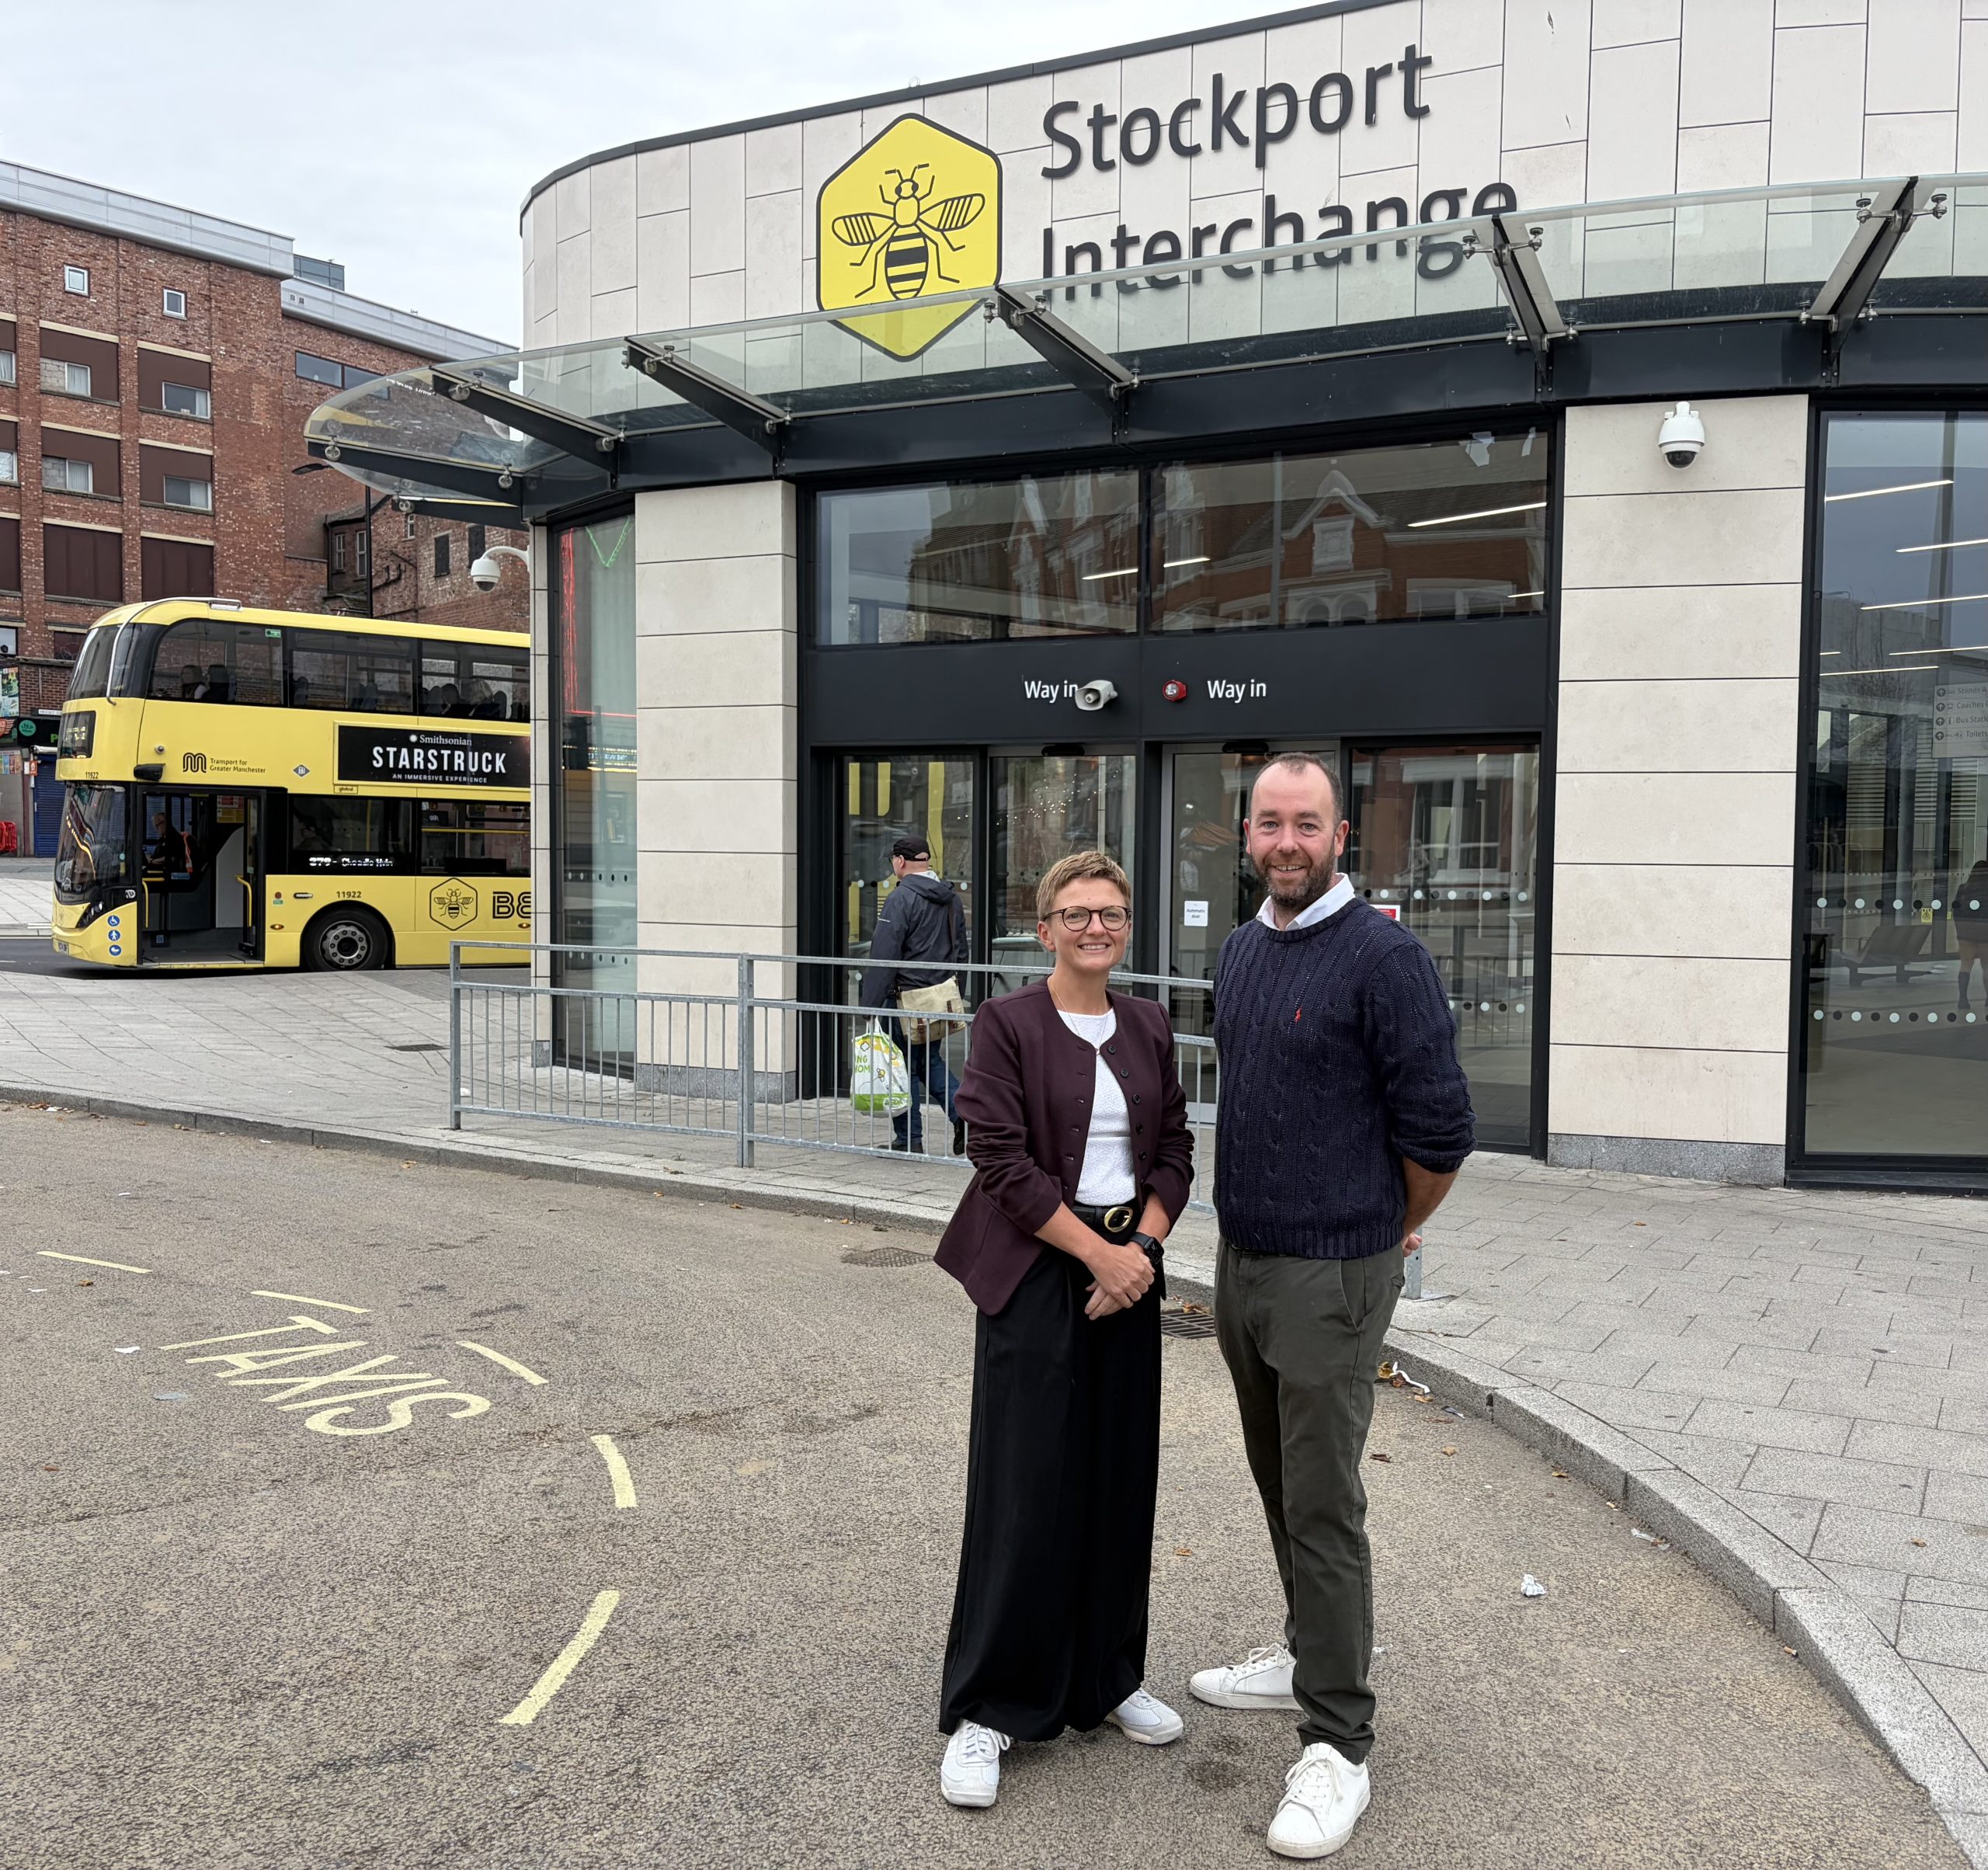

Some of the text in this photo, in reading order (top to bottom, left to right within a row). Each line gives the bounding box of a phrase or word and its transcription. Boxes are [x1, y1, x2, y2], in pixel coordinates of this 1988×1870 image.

[1041, 43, 1433, 179] Stockport
[1043, 182, 1518, 301] Interchange
[1024, 680, 1078, 704] Way in
[1207, 680, 1267, 704] Way in
[419, 734, 472, 746] Smithsonian
[372, 746, 506, 773] STARSTRUCK
[160, 1315, 491, 1436] TAXIS
